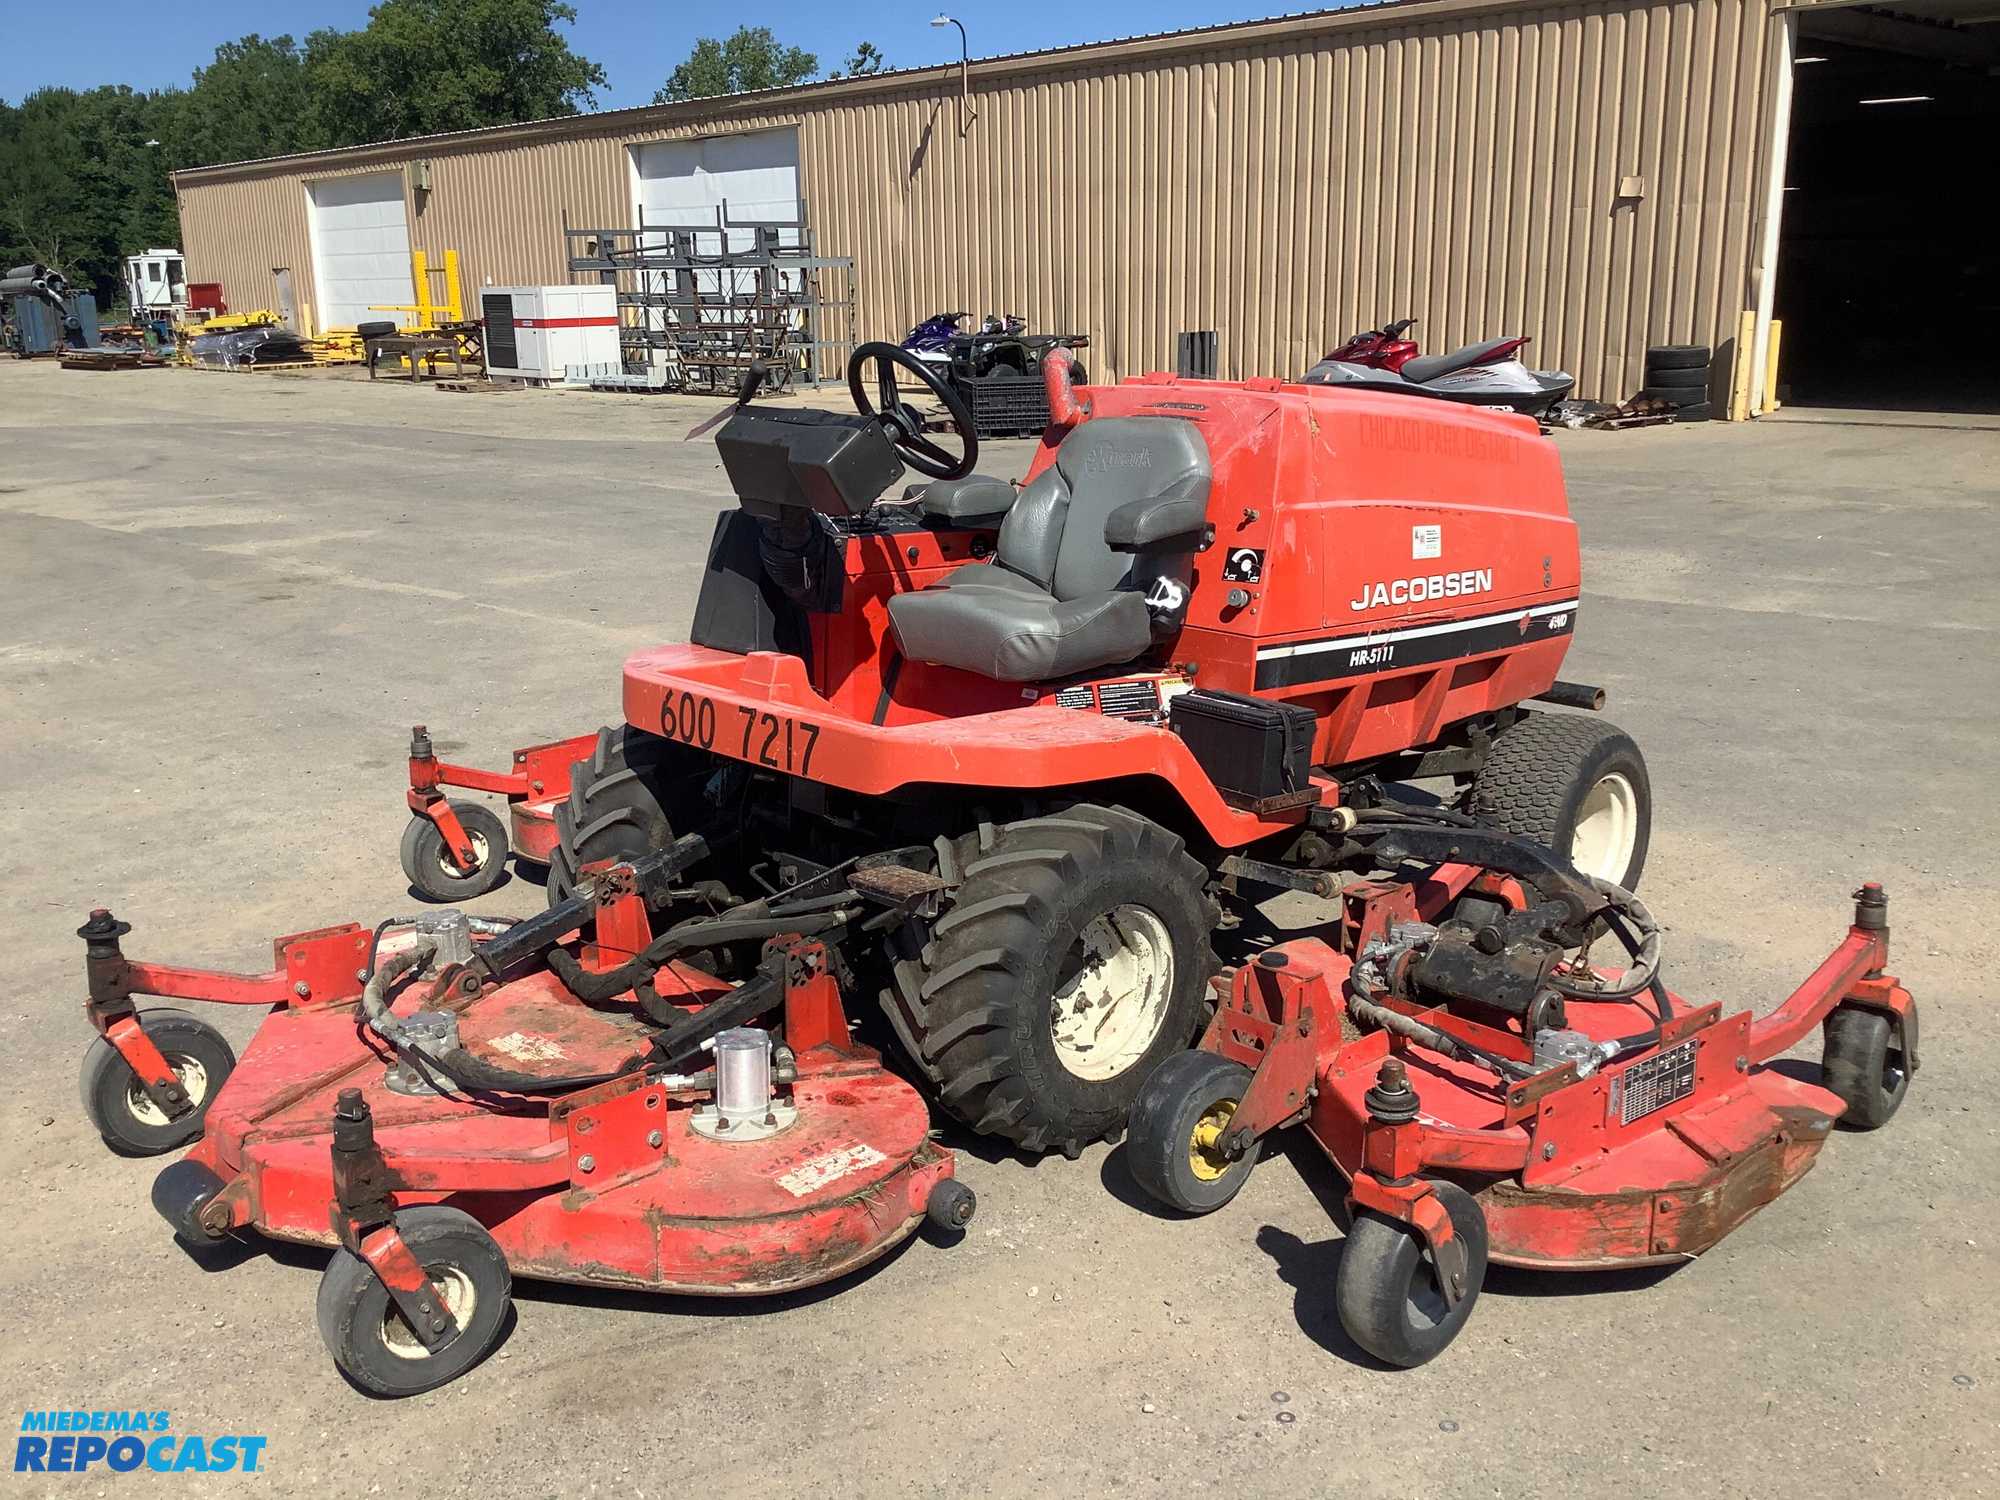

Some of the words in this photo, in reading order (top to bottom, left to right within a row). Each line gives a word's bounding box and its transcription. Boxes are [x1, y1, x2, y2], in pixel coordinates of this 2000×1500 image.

[1360, 414, 1421, 454] CHICAGO
[1426, 421, 1462, 457] PARK
[1350, 567, 1493, 612] JACOBSEN
[1350, 646, 1394, 667] HR-5111
[661, 689, 716, 749] 600
[739, 706, 820, 776] 7217
